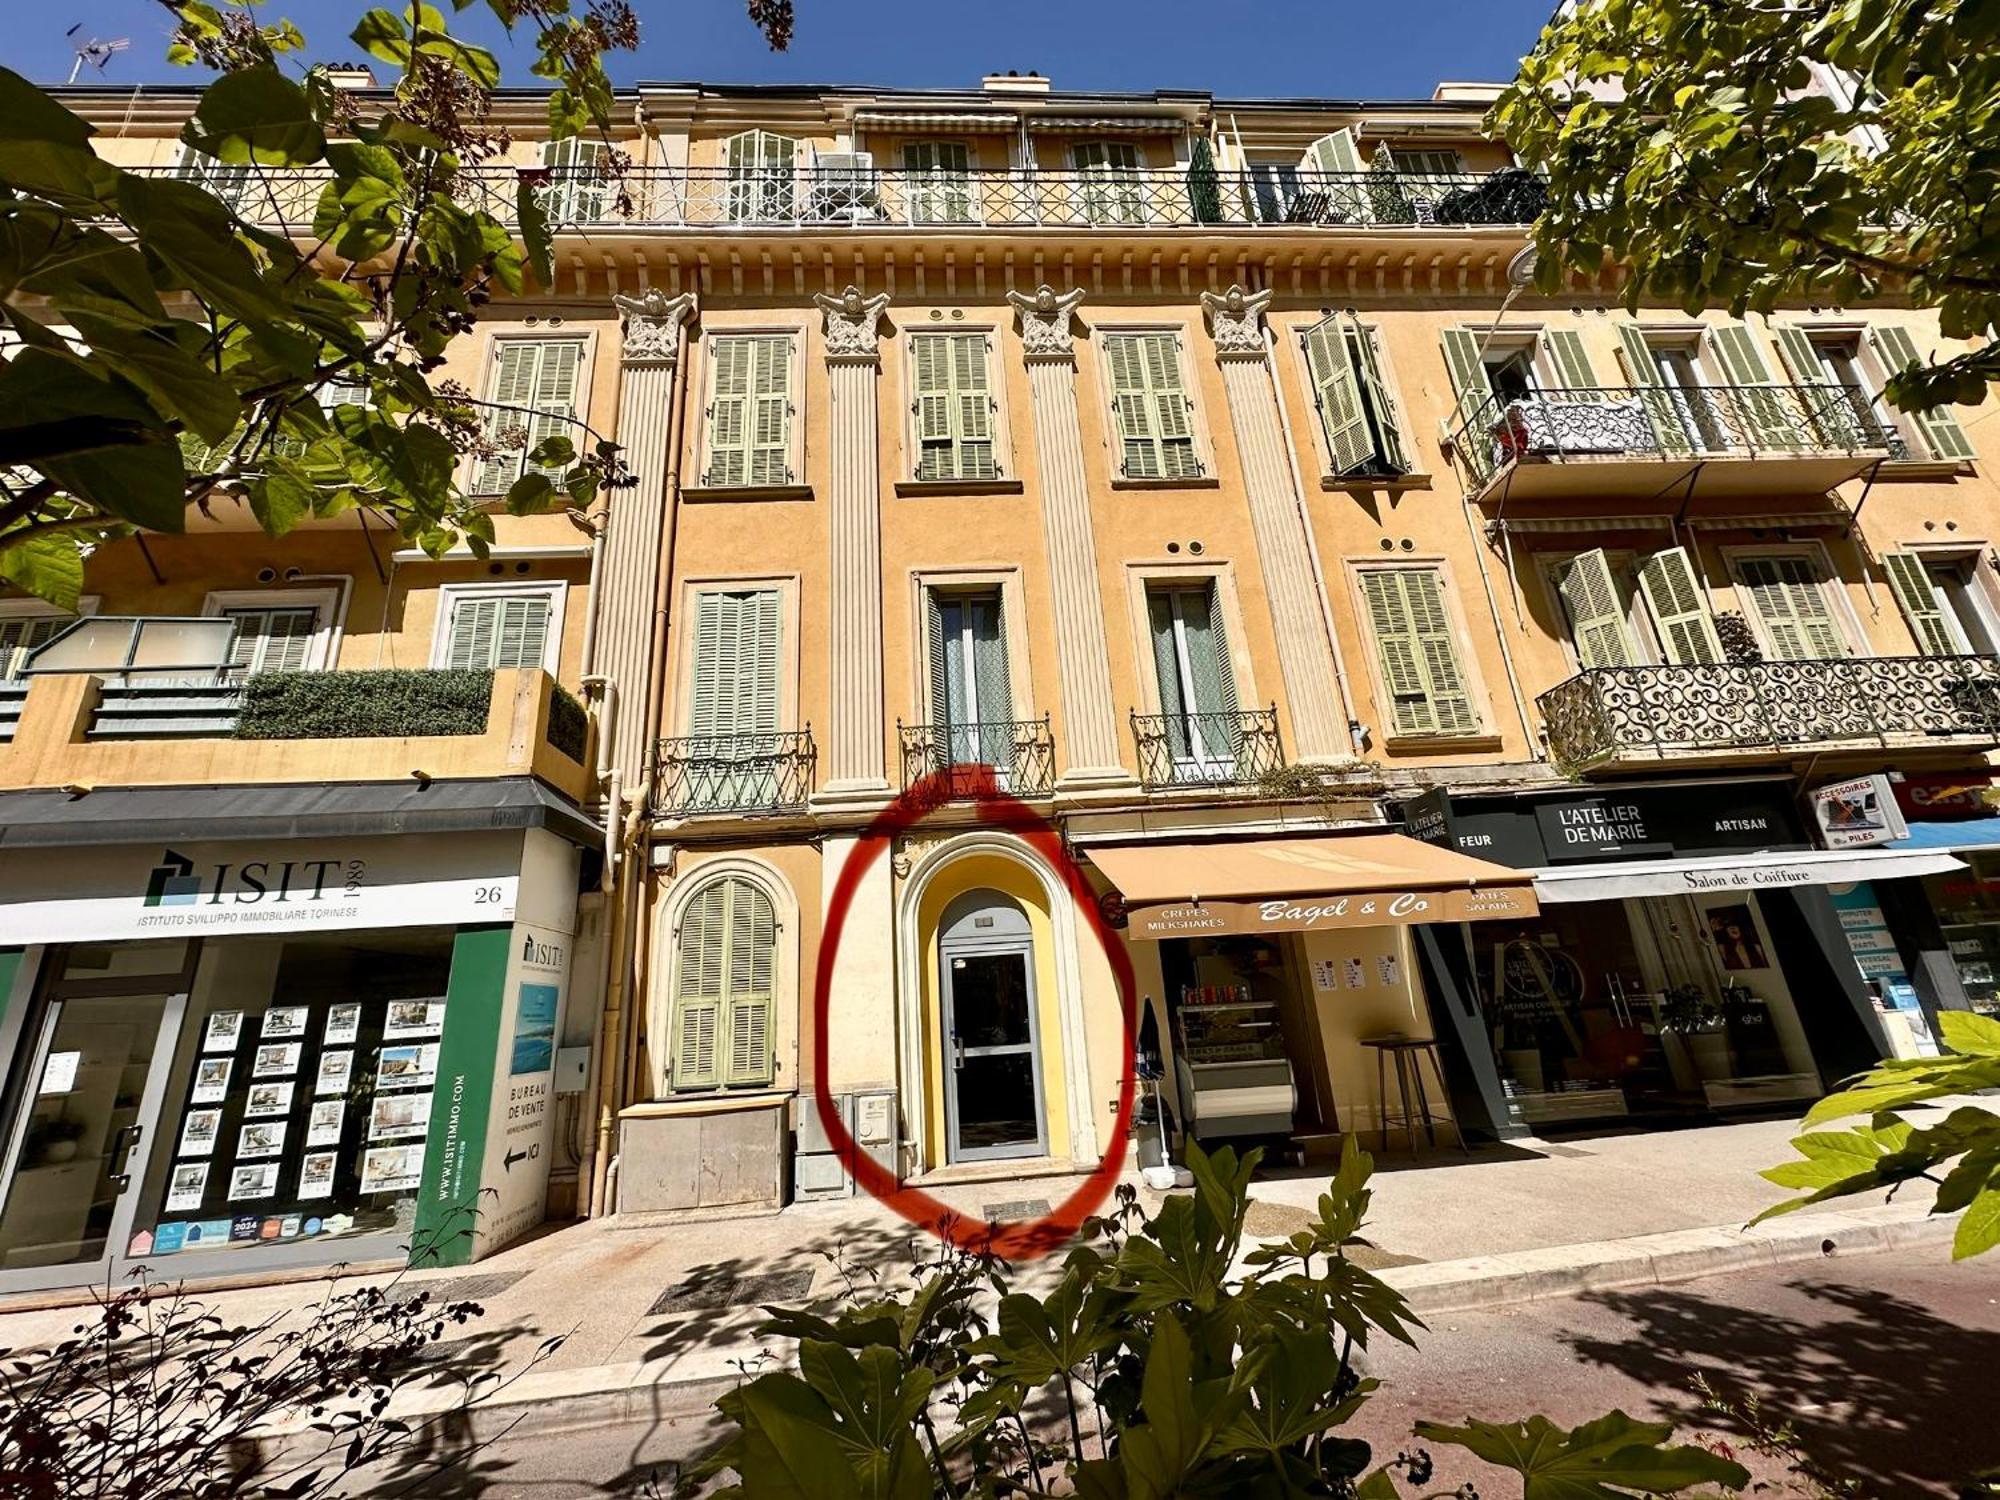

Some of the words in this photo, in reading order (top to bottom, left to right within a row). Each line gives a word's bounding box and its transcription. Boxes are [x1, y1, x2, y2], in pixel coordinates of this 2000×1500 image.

[1815, 780, 1872, 801] ACCESSOIRES
[1559, 805, 1641, 826] L'ATELIER
[1715, 818, 1767, 832] ARTISAN
[1459, 834, 1493, 847] FEUR
[1591, 823, 1648, 842] MARIE
[1848, 831, 1875, 844] PILES
[205, 860, 342, 905] ISIT
[344, 859, 366, 898] 1989
[1683, 870, 1727, 889] Salon
[1731, 874, 1749, 885] de
[1752, 870, 1811, 884] Coiffure
[474, 886, 502, 904] 26
[1259, 898, 1349, 926] Bagel
[1360, 900, 1376, 914] &
[1388, 893, 1430, 917] Co
[1464, 901, 1520, 912] SALADES
[137, 913, 185, 927] ISTITUTO
[186, 911, 238, 925] SVILUPPO
[240, 909, 307, 923] IMMOBILIARE
[309, 907, 358, 920] TORINESE
[1147, 918, 1225, 930] MILKSHAKES
[535, 943, 560, 966] ISIT
[510, 1083, 546, 1101] BUREAU
[508, 1105, 520, 1119] DE
[521, 1100, 545, 1117] VENTE
[438, 1074, 465, 1201] WWW.ISITIMMO.COM
[527, 1143, 540, 1161] ICI
[234, 1221, 258, 1231] 2024
